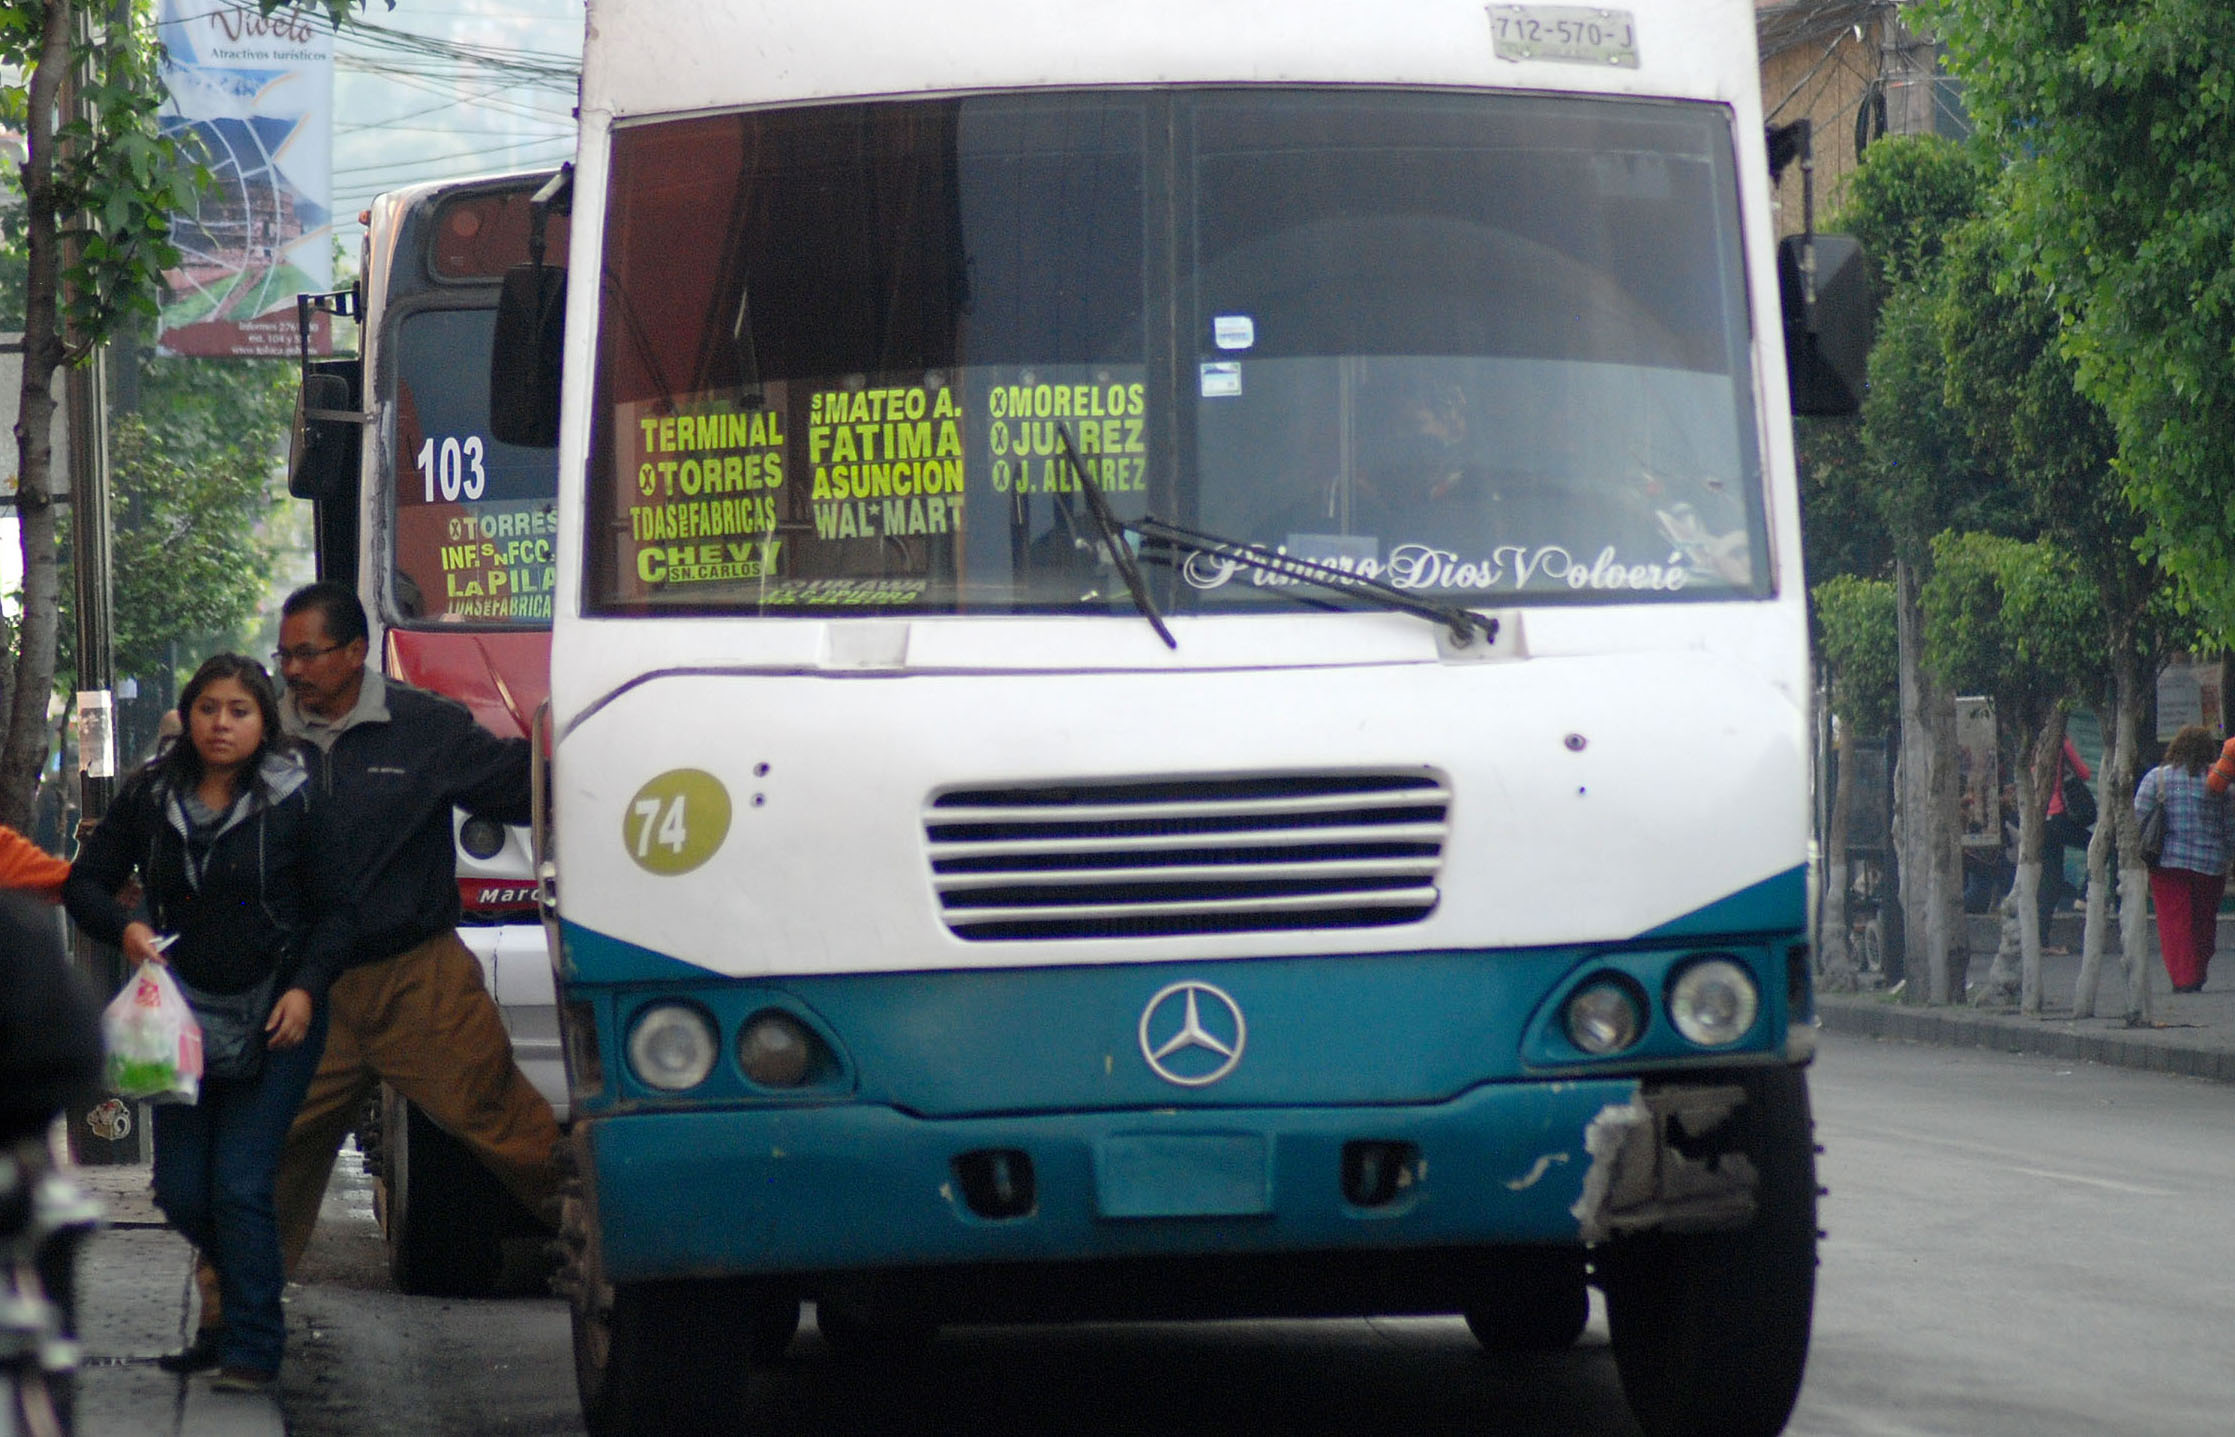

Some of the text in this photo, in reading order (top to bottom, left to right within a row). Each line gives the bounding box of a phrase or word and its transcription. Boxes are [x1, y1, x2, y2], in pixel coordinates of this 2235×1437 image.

[1496, 17, 1633, 48] 712-570-J
[211, 47, 269, 60] Atractivos
[825, 388, 926, 424] MATEO
[933, 387, 962, 418] A.
[1008, 383, 1145, 417] MORELOS
[640, 411, 784, 452] TERMINAL
[809, 420, 962, 463] FATIMA
[417, 435, 485, 502] 103
[658, 452, 784, 496] TORRES
[811, 459, 965, 500] ASUNCION
[1016, 460, 1037, 494] J.
[463, 509, 558, 540] TORRES
[447, 566, 555, 597] LA PILA
[637, 541, 782, 583] CHEVY
[670, 562, 761, 581] SN. CARLOS
[1388, 544, 1502, 590] Dios
[635, 795, 686, 857] 74
